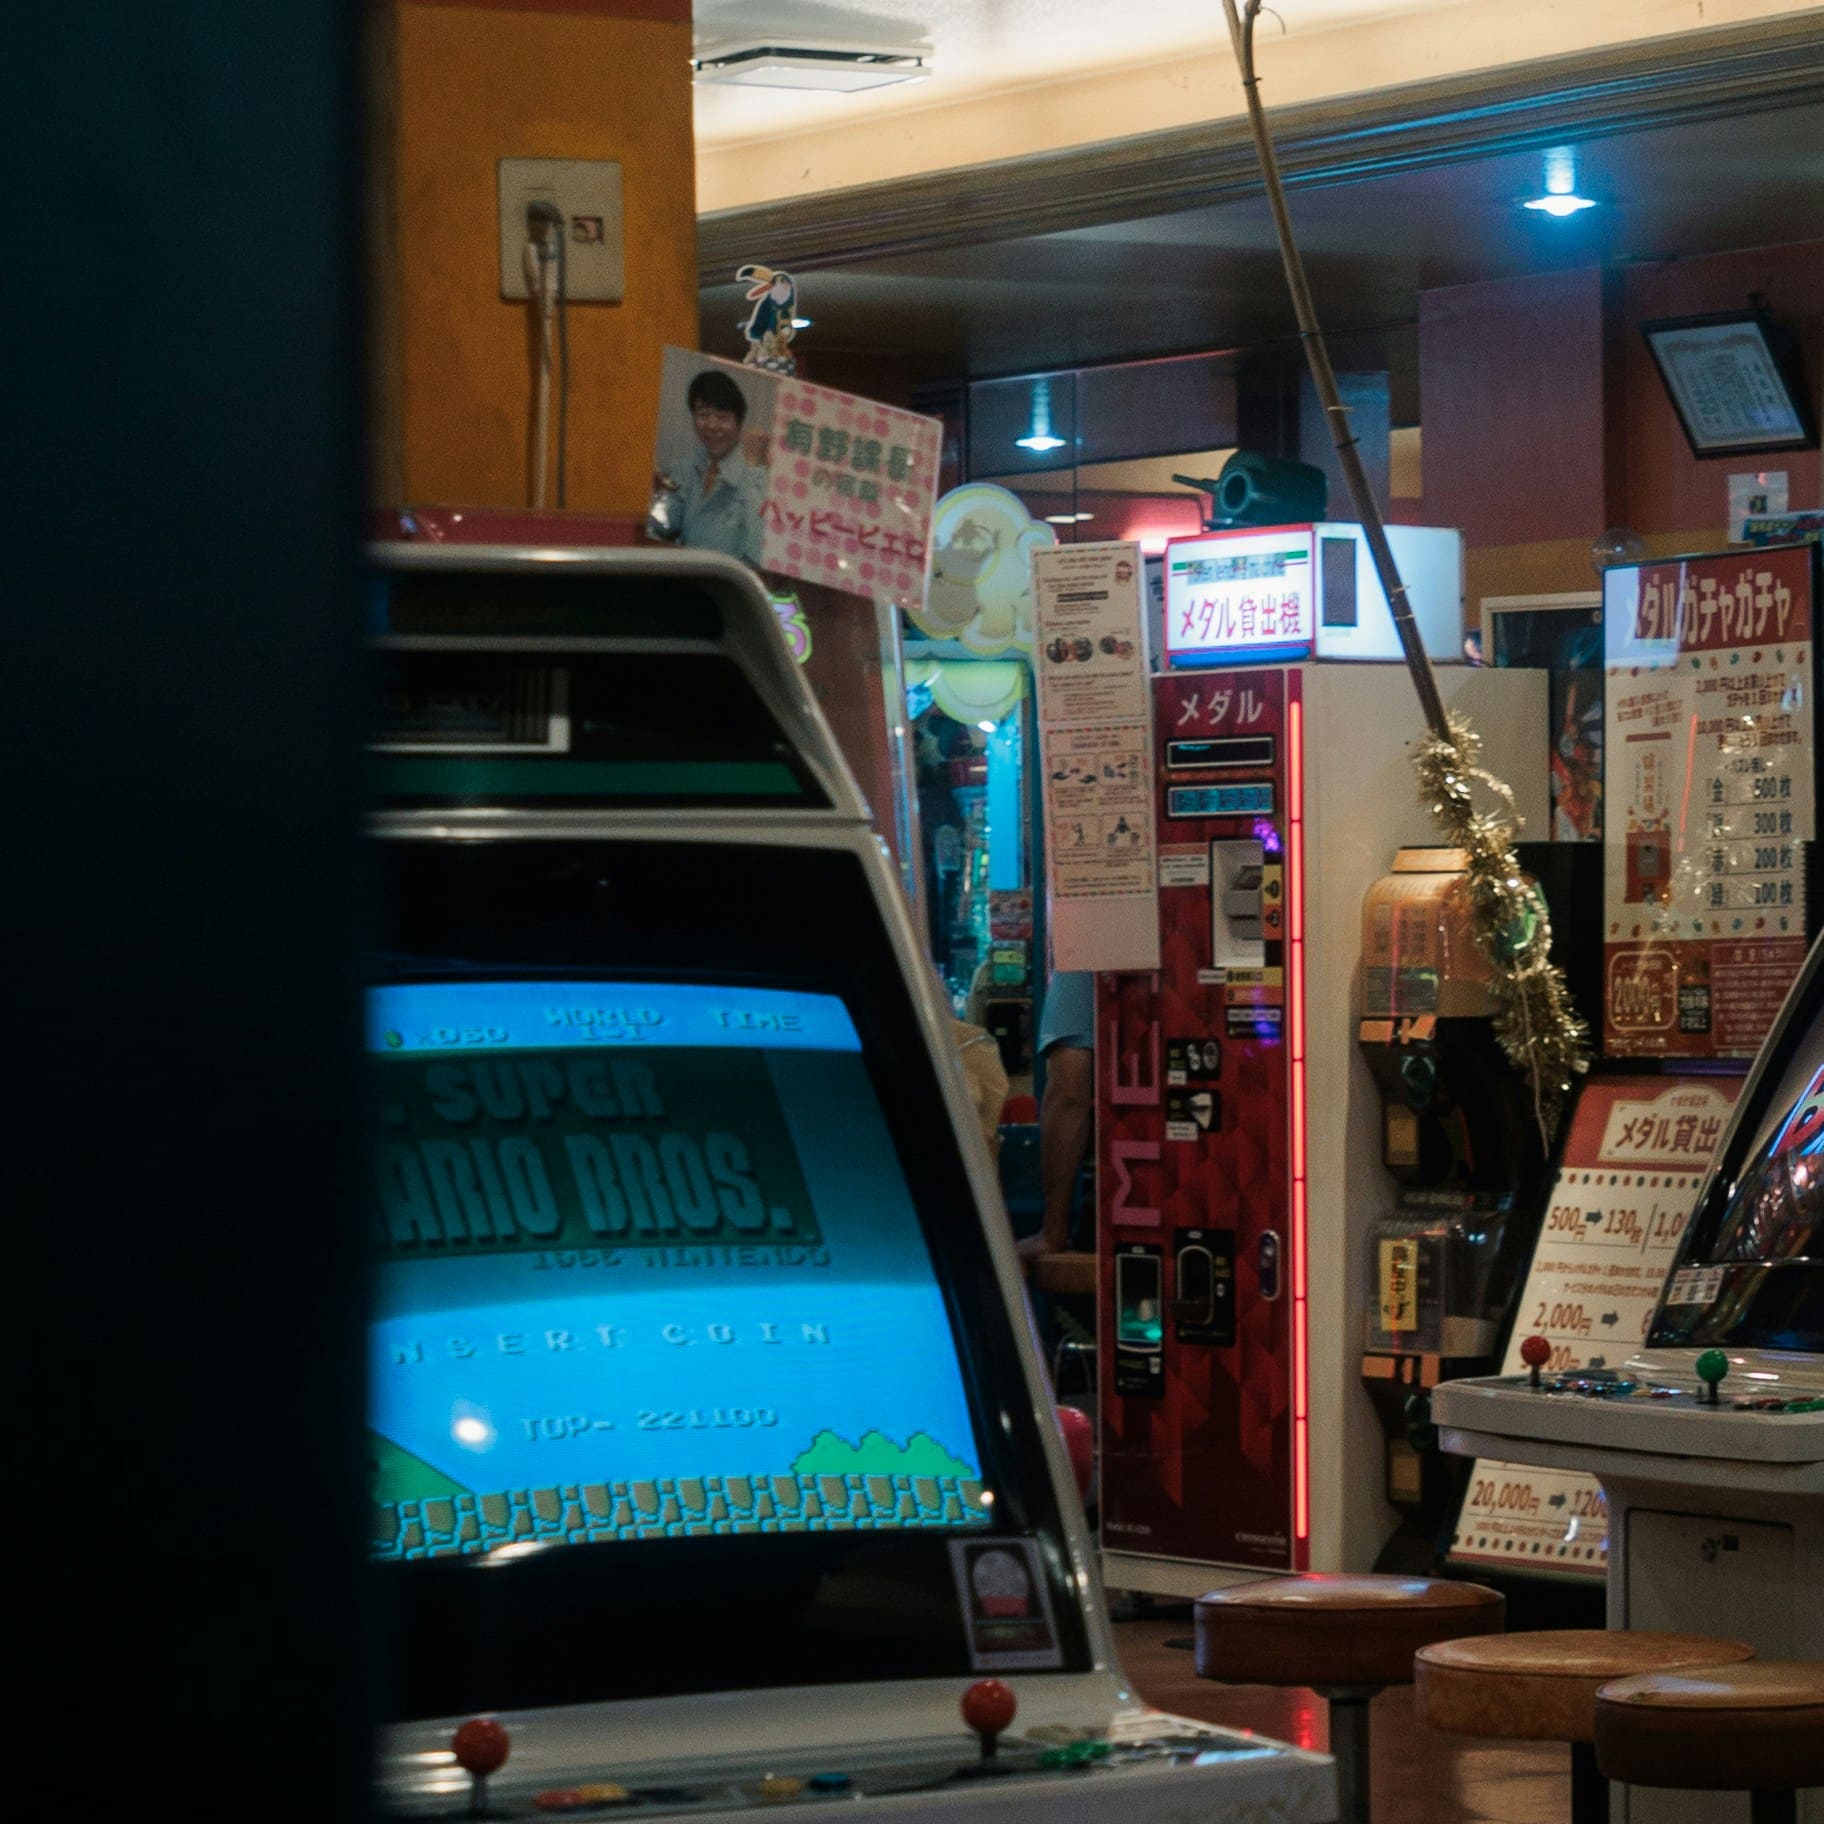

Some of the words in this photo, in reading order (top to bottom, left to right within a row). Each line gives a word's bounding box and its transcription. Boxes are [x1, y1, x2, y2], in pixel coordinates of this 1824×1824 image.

[1180, 591, 1303, 641] メダル貸出機
[1177, 688, 1264, 726] メダル
[544, 1007, 664, 1027] WORLD
[711, 1009, 803, 1033] TIME
[580, 1025, 648, 1042] 1-1
[423, 1059, 668, 1123] SUPER
[564, 1131, 797, 1238] BROS.
[1547, 1205, 1587, 1242] 500円
[643, 1246, 834, 1270] NINTENDO
[659, 1321, 831, 1347] COIN
[1532, 1301, 1593, 1336] 2,000円
[521, 1415, 616, 1443] TOP-
[636, 1407, 779, 1431] 221100
[1471, 1479, 1541, 1515] 20,000円
